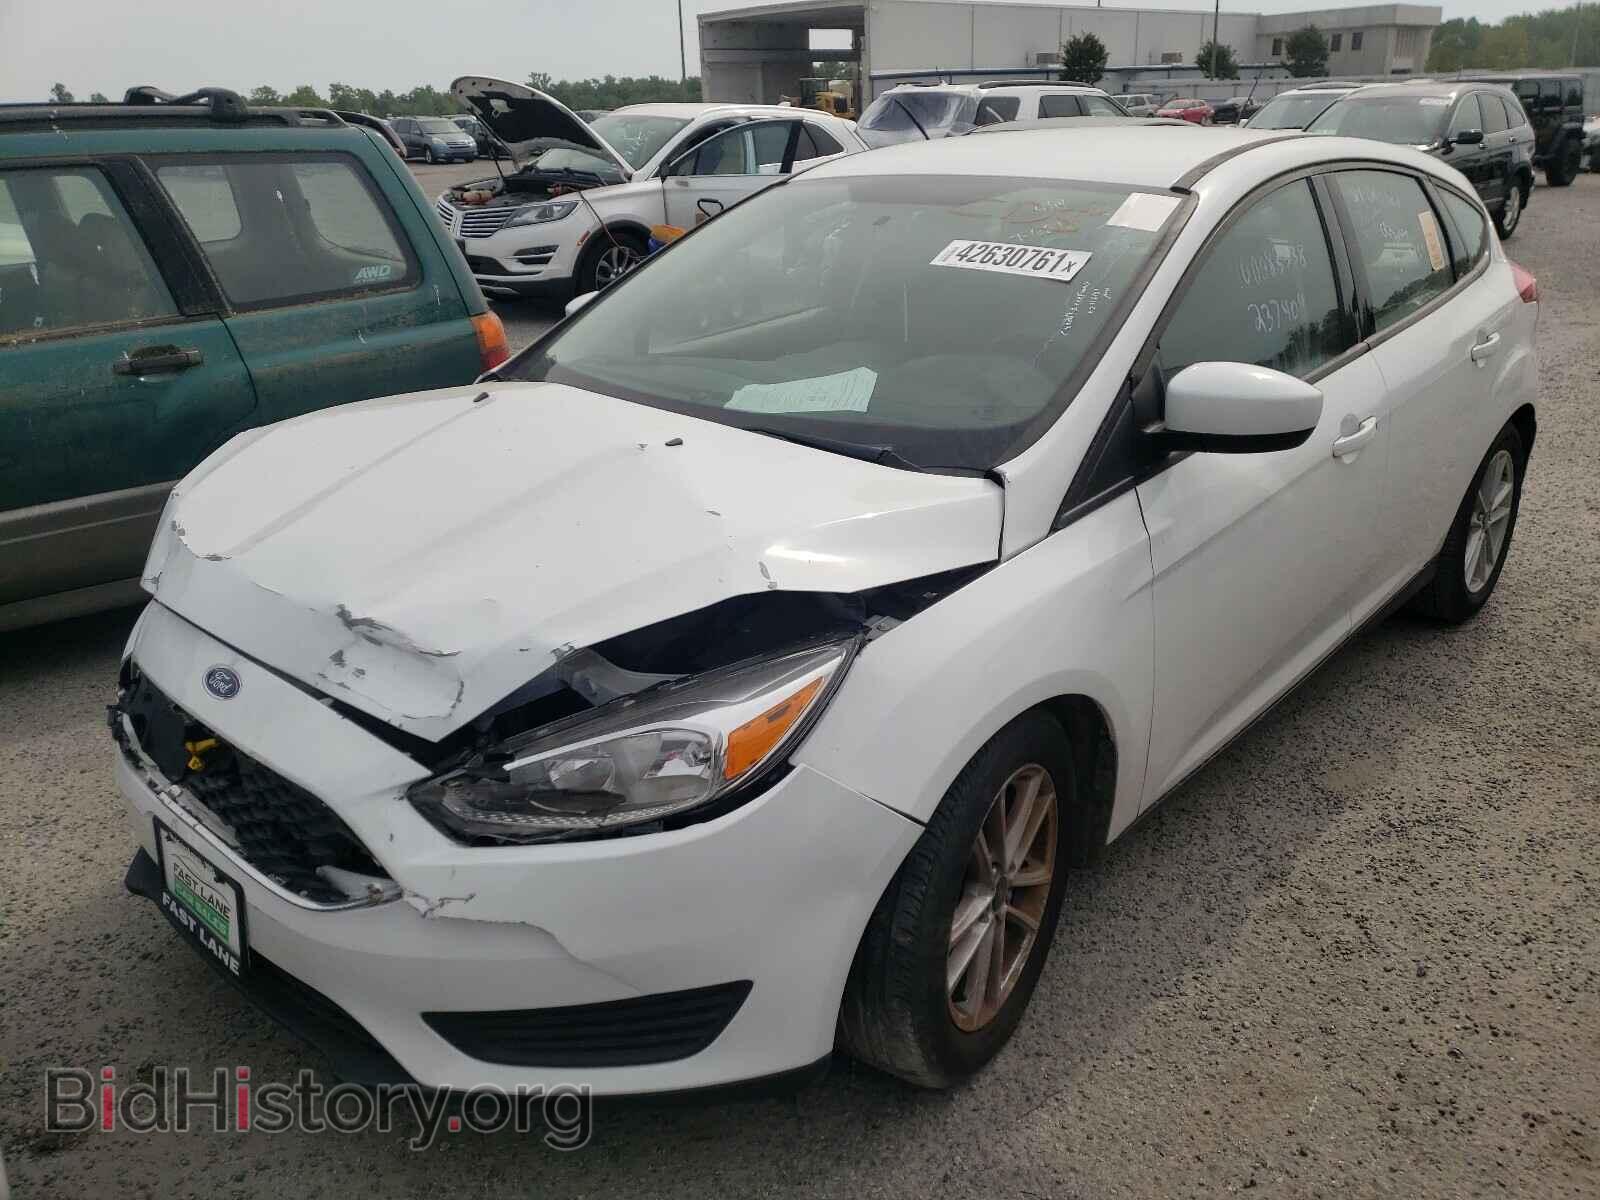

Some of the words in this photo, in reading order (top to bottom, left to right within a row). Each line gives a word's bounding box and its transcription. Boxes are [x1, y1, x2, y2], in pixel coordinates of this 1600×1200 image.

[355, 264, 391, 280] AWD
[955, 243, 1068, 273] 42630761
[173, 862, 199, 894] FAST
[200, 886, 231, 919] LANE
[162, 891, 197, 932] FAST
[200, 928, 240, 976] LANE
